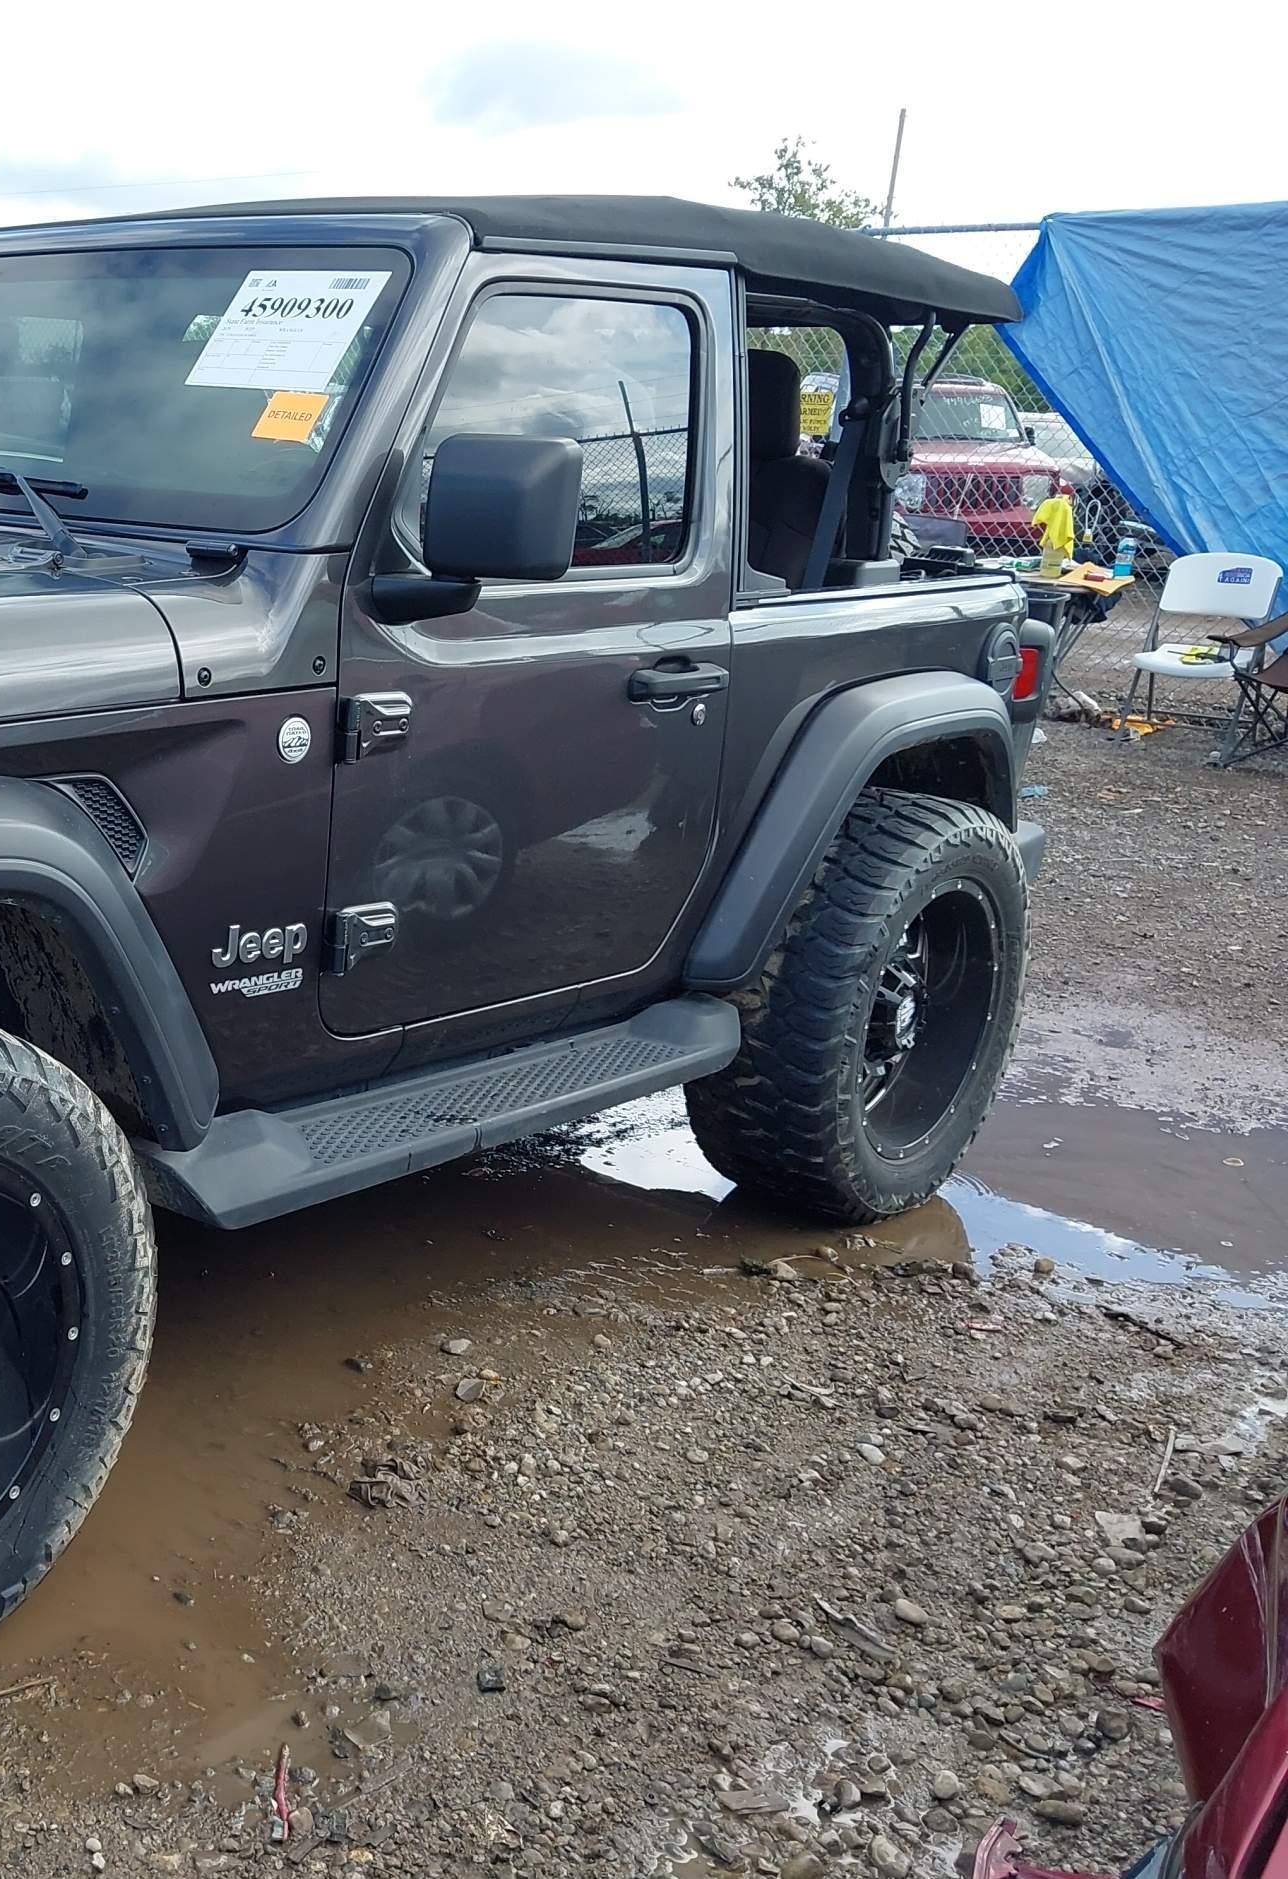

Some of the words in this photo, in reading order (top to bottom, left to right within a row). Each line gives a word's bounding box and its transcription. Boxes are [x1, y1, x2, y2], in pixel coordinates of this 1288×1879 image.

[240, 297, 354, 319] 45909300
[800, 393, 830, 404] RNING
[266, 409, 313, 422] DETAILED
[211, 922, 308, 968] Jeep
[210, 968, 304, 995] WRANGLER
[245, 979, 303, 996] SPORT
